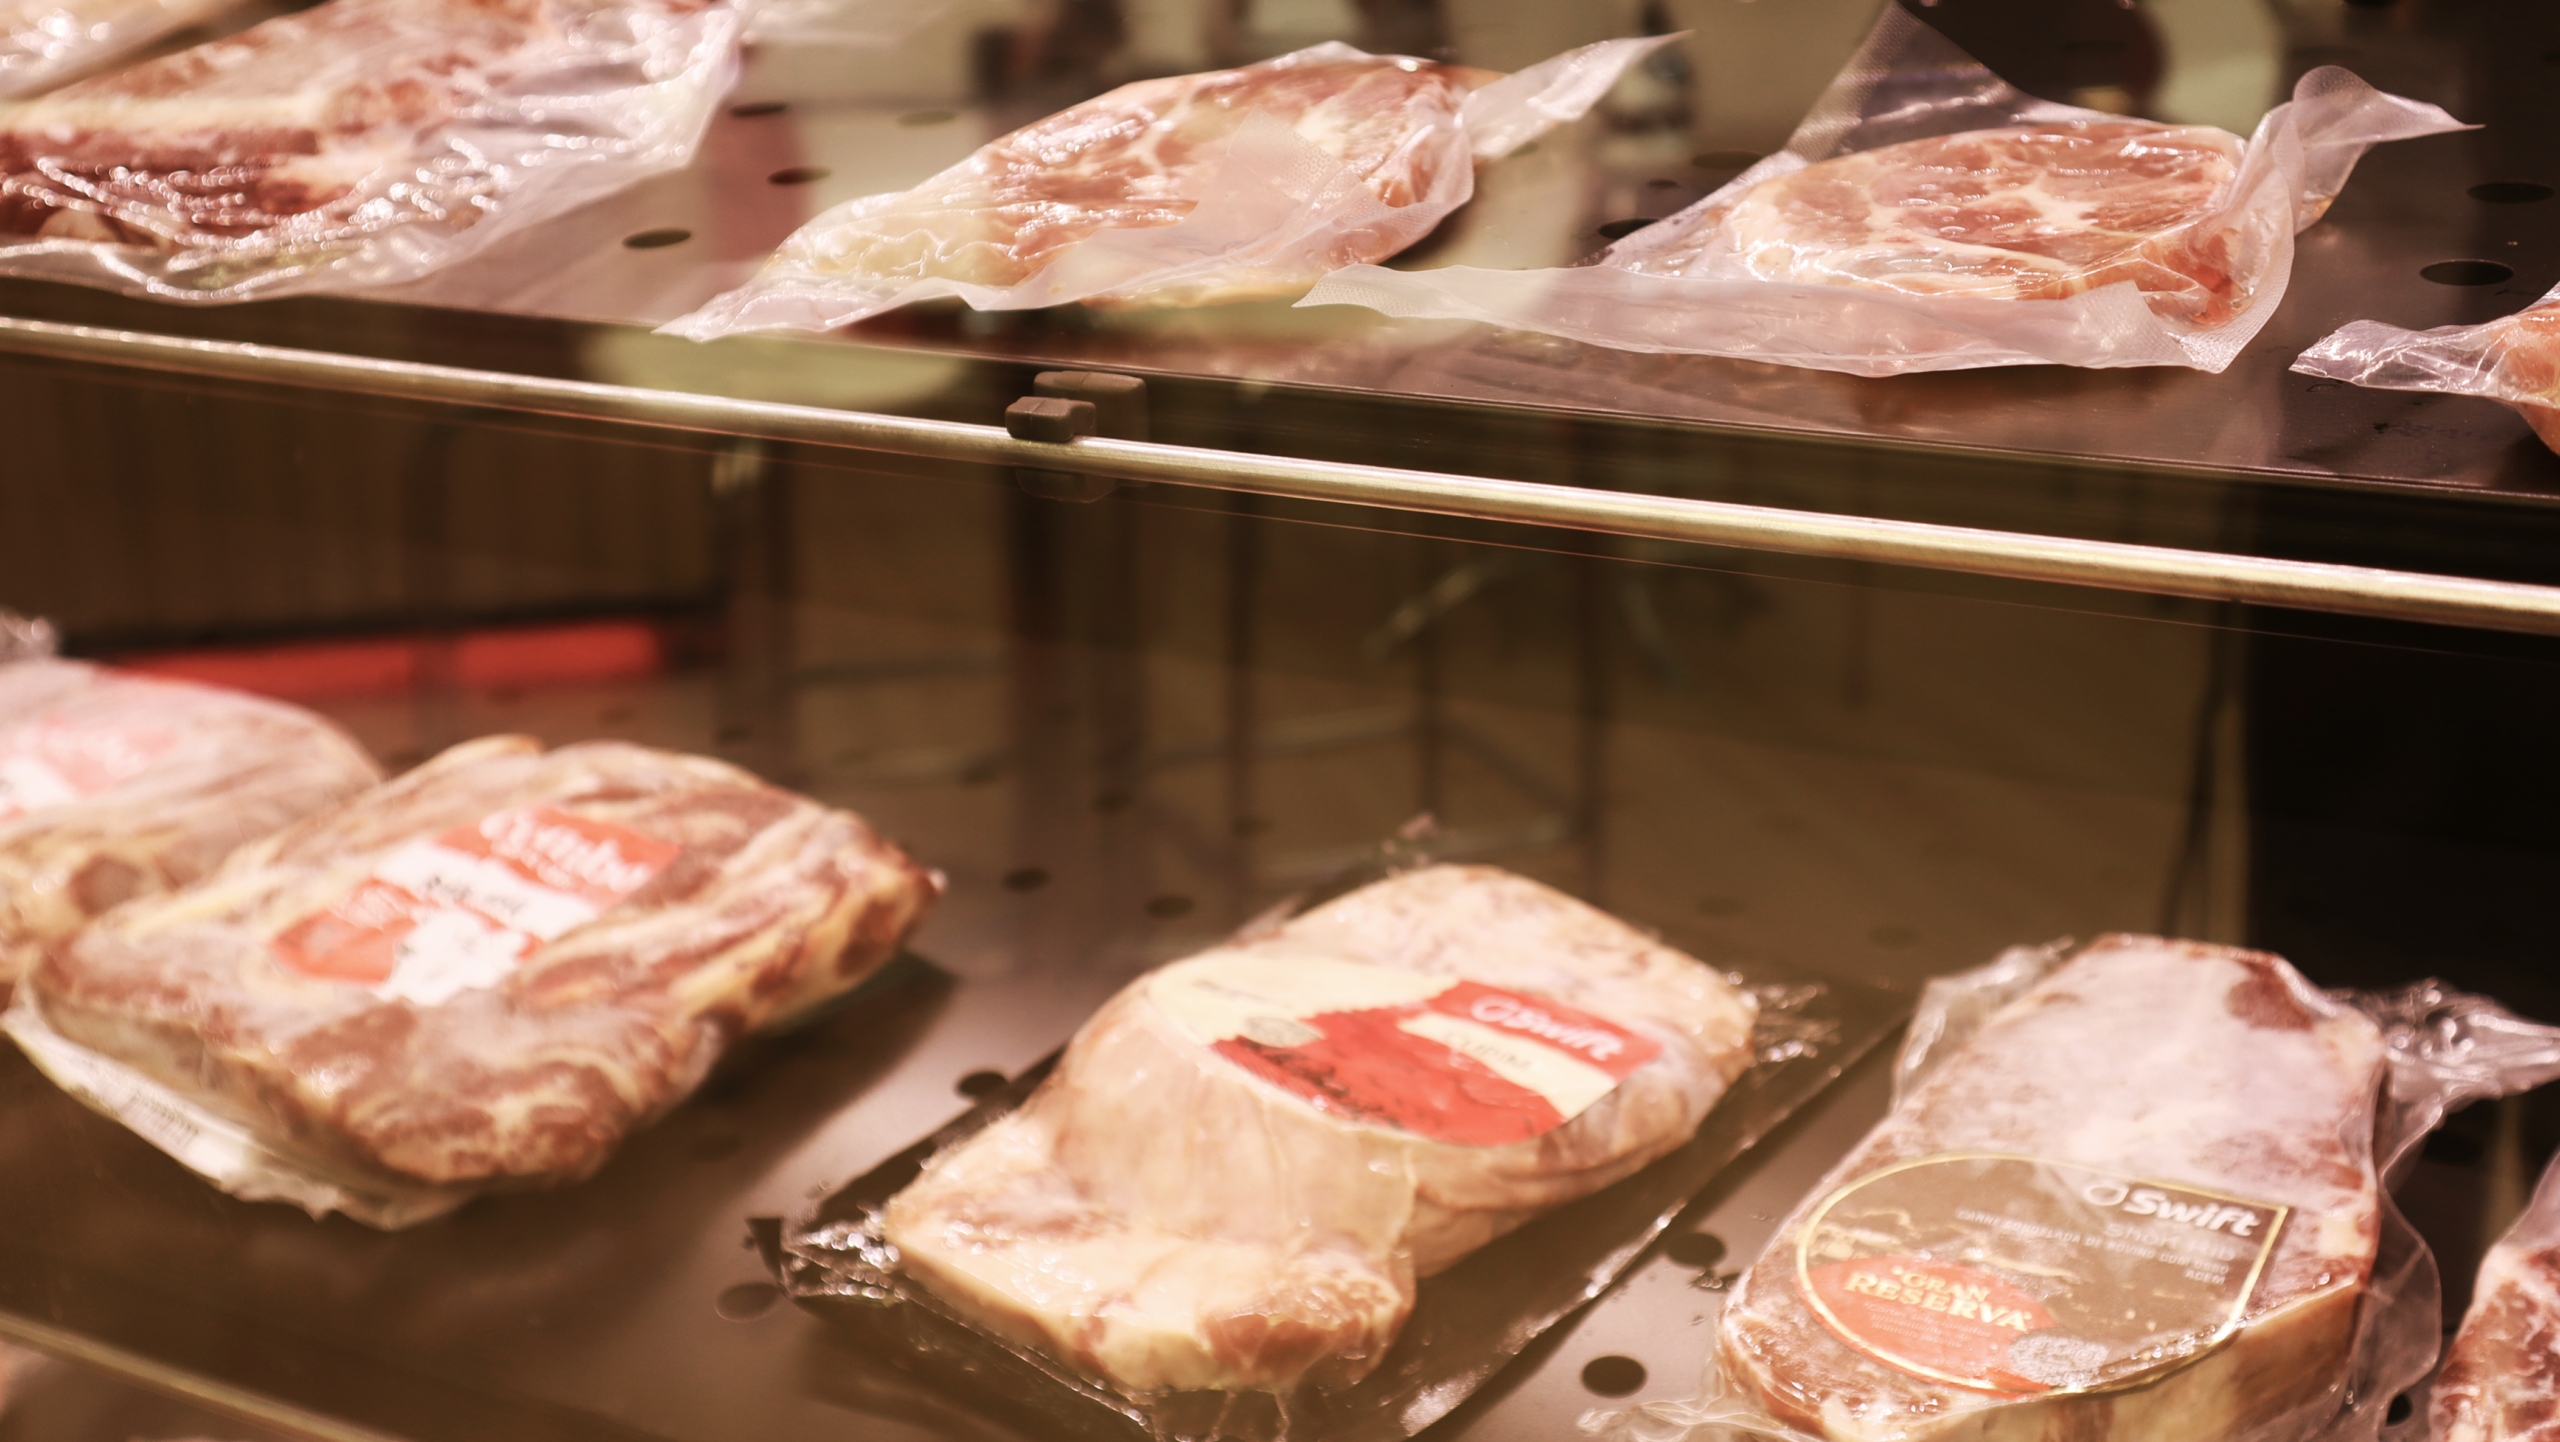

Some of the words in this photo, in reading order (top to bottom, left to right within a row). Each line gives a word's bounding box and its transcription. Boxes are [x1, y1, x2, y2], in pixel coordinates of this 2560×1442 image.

[2124, 1188, 2260, 1237] Swift
[1843, 1272, 2029, 1334] RESERVA
[1901, 1270, 1991, 1302] GRAN
